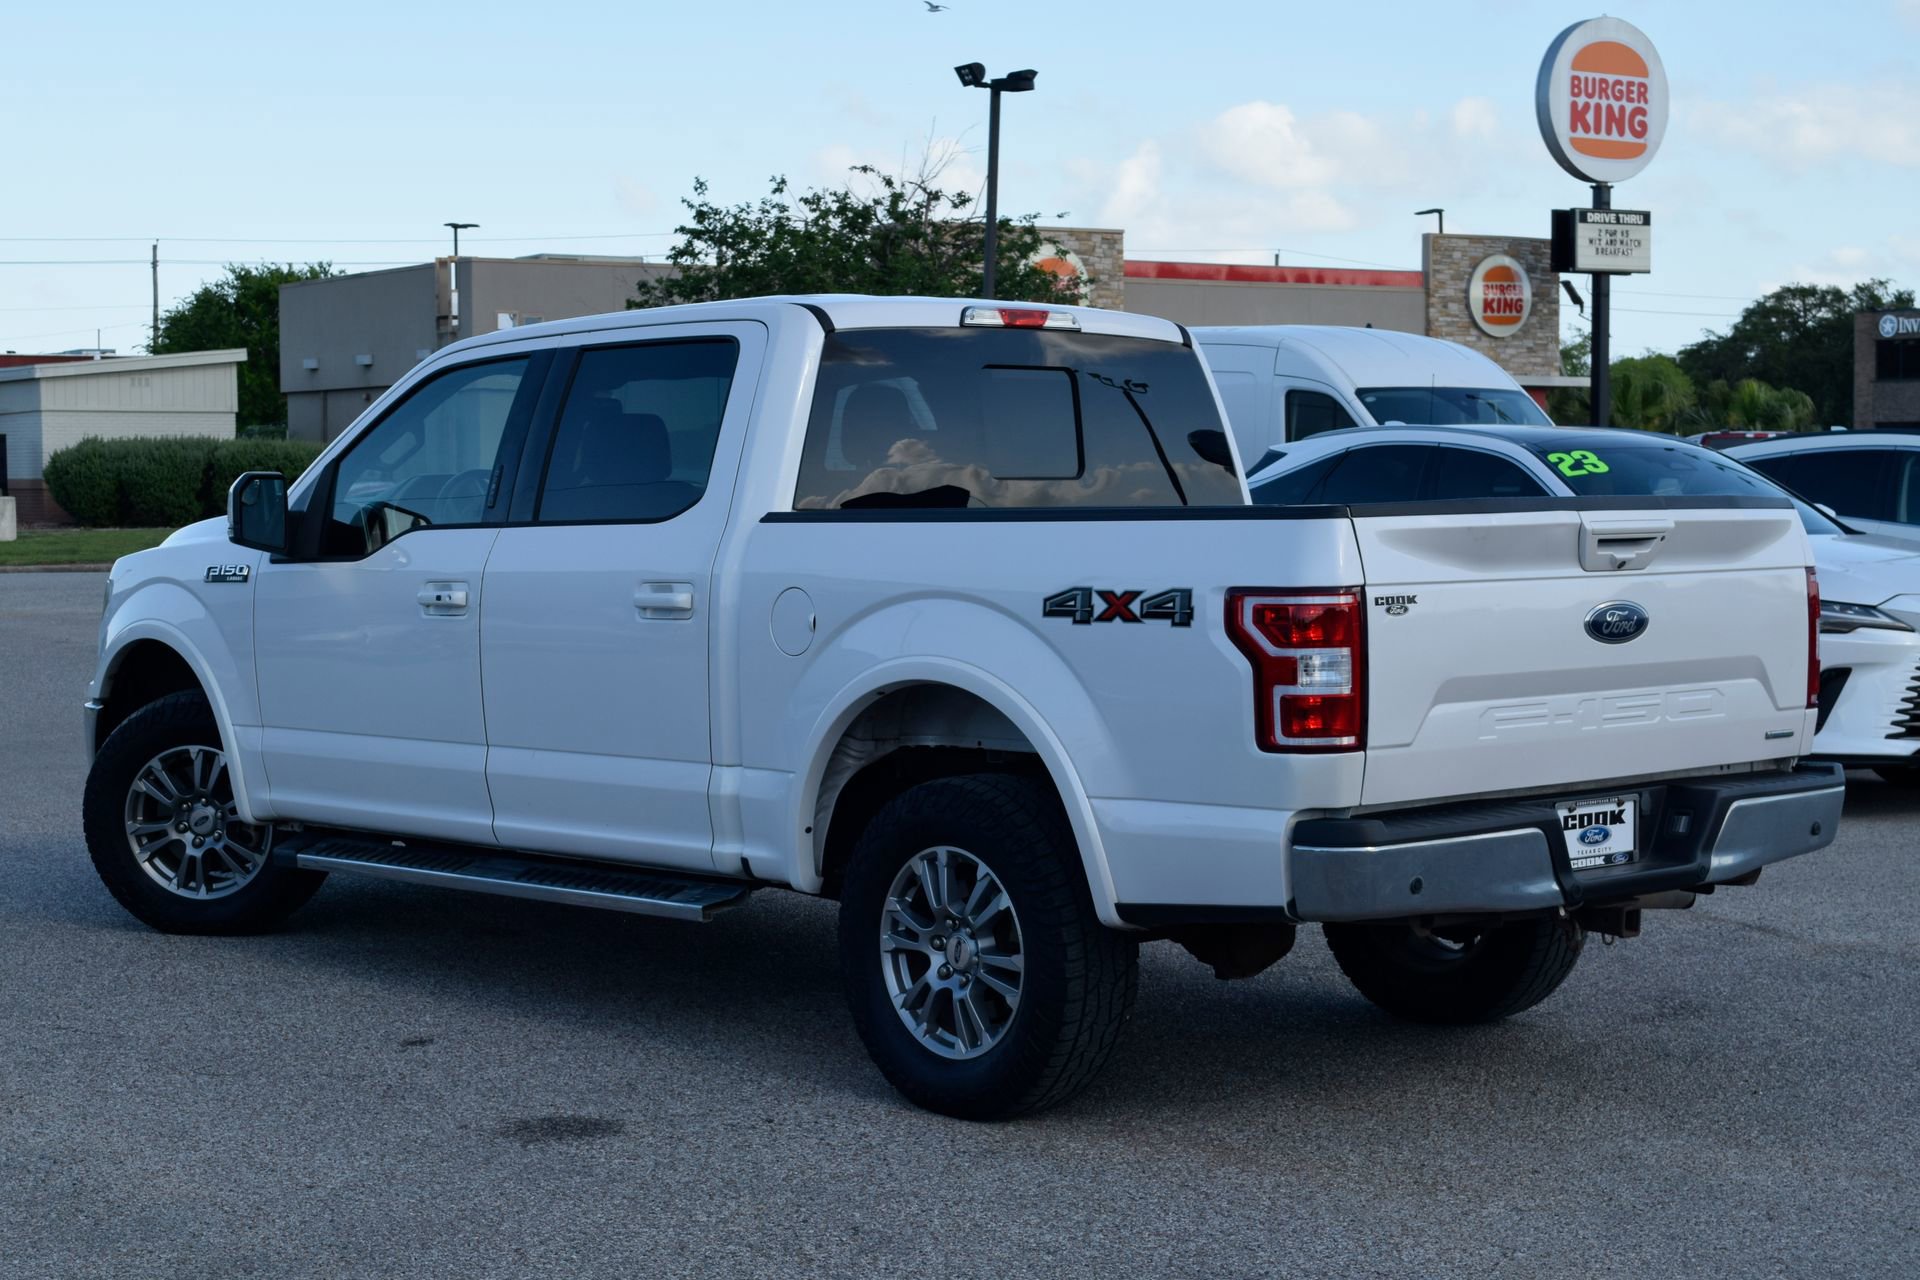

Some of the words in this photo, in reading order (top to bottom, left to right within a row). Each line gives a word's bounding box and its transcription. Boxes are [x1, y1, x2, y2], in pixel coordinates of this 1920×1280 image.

[1570, 75, 1648, 104] BURGER
[1570, 100, 1649, 139] KING
[1587, 212, 1617, 223] DRIVE
[1619, 213, 1644, 224] THRU
[1605, 229, 1618, 238] FOR
[1588, 238, 1602, 247] MIX
[1606, 239, 1618, 247] AND
[1620, 239, 1641, 248] MATCH
[1595, 247, 1633, 257] BREAKFAST
[1482, 283, 1523, 297] BURGER
[1483, 297, 1524, 314] KING
[1547, 450, 1609, 477] 23
[1374, 595, 1418, 606] COOK
[1602, 610, 1638, 634] Ford
[1478, 688, 1726, 740] F-150
[1563, 809, 1626, 830] COOK
[1584, 829, 1605, 843] Ford
[1570, 856, 1605, 868] COOK
